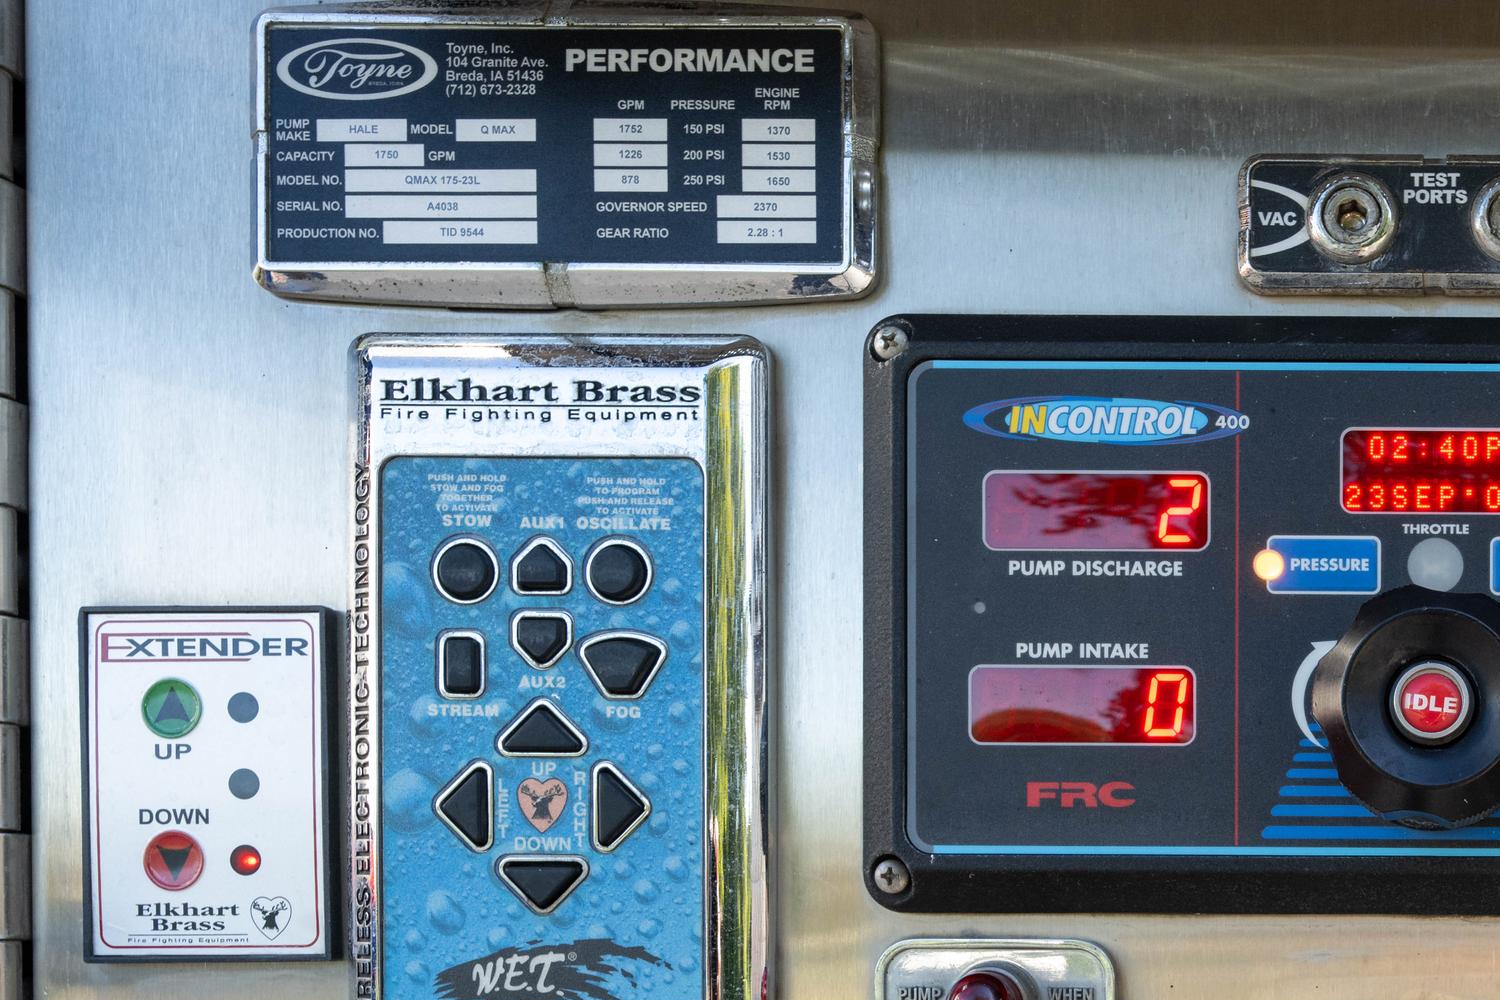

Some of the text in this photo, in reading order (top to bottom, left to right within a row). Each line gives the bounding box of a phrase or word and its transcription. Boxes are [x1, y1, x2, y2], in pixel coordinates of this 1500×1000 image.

[446, 43, 514, 54] Toyne, Inc.
[447, 57, 548, 68] 104 Granite Ave.
[566, 49, 814, 72] PERFORMANCE
[304, 50, 412, 88] Toyne
[446, 71, 543, 83] Breda, IA 51436
[446, 84, 536, 97] (712) 673-2328
[755, 88, 800, 98] ENGINE
[618, 100, 644, 110] GPM
[671, 100, 735, 110] PRESSURE
[764, 100, 790, 110] RPM
[276, 120, 309, 129] PUMP
[349, 125, 378, 134] HALE
[411, 124, 452, 134] MODEL
[619, 125, 642, 133] 1752
[684, 125, 724, 134] 150 PSI
[767, 126, 790, 135] 1370
[276, 132, 310, 141] MAKE
[276, 152, 334, 161] CAPACITY
[375, 150, 398, 159] 1750
[619, 150, 642, 158] 1226
[767, 152, 790, 160] 1530
[767, 177, 790, 186] 1650
[1411, 173, 1460, 187] TEST
[1403, 190, 1468, 204] PORTS
[277, 202, 342, 211] SERIAL NO.
[427, 202, 458, 211] A4038
[1258, 212, 1297, 226] VAC
[277, 228, 379, 238] PRODUCTION NO.
[380, 378, 700, 403] Elkhart Brass
[381, 408, 699, 422] Fire Fighting Equipment
[1010, 405, 1249, 435] INCONTROL 400
[1158, 479, 1201, 543] 2
[442, 515, 491, 527] STOW
[520, 517, 564, 529] AUX1
[577, 517, 671, 530] OSCILLATE
[1402, 524, 1469, 535] THROTTLE
[354, 462, 371, 668] TECHNOLOGY
[1009, 561, 1182, 576] PUMP DISCHARGE
[1291, 558, 1369, 571] PRESSURE
[101, 632, 308, 662] EXTENDER
[1016, 643, 1149, 658] PUMP INTAKE
[1144, 674, 1188, 737] 0
[1404, 693, 1458, 715] IDLE
[428, 704, 500, 717] STREAM
[606, 706, 640, 719] FOG
[155, 744, 192, 760] UP
[354, 678, 371, 877] ELECTRONIC
[1027, 782, 1136, 808] FRC
[573, 772, 586, 847] RIGHT
[139, 809, 210, 825] DOWN
[136, 903, 240, 917] Elkhart
[151, 919, 225, 931] Brass
